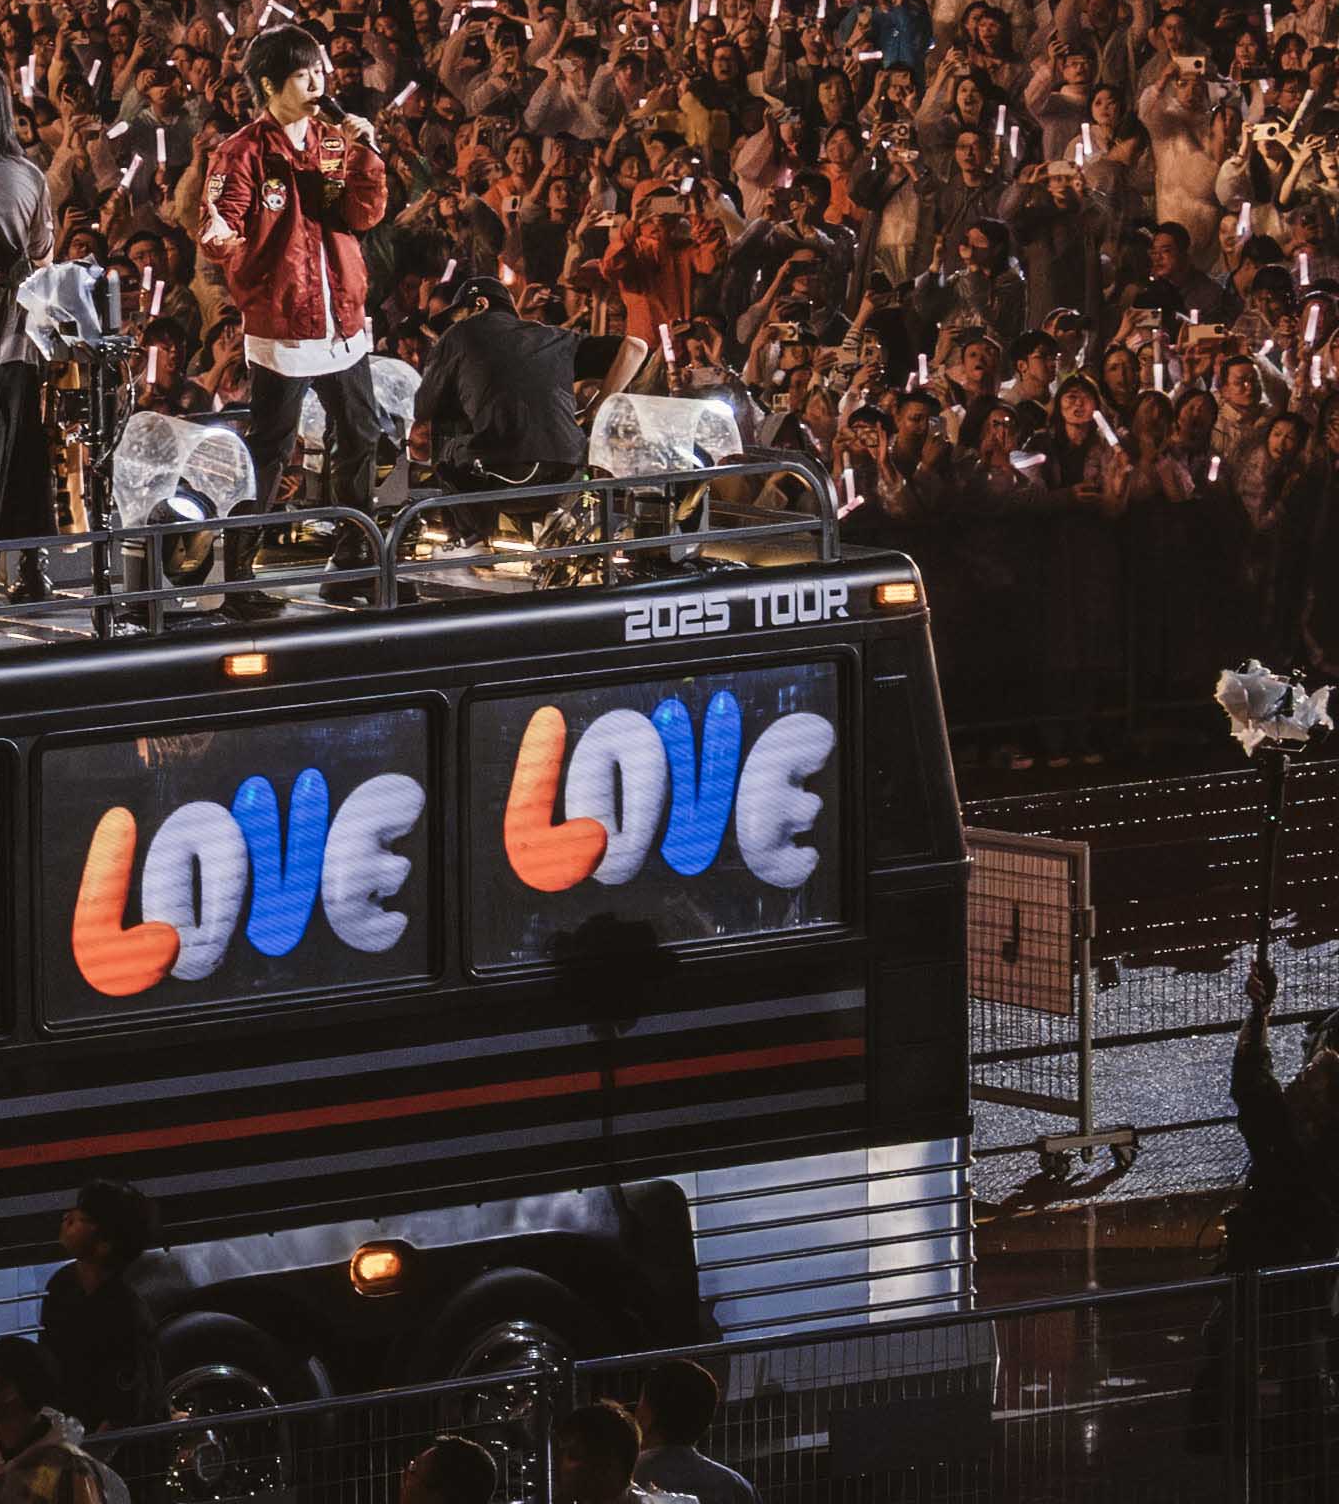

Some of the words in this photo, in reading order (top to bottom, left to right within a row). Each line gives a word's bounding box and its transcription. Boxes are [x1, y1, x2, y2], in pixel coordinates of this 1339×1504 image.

[625, 601, 729, 640] 2025
[753, 579, 849, 628] TOUR
[72, 767, 426, 998] LOVE
[504, 689, 835, 892] LOVE
